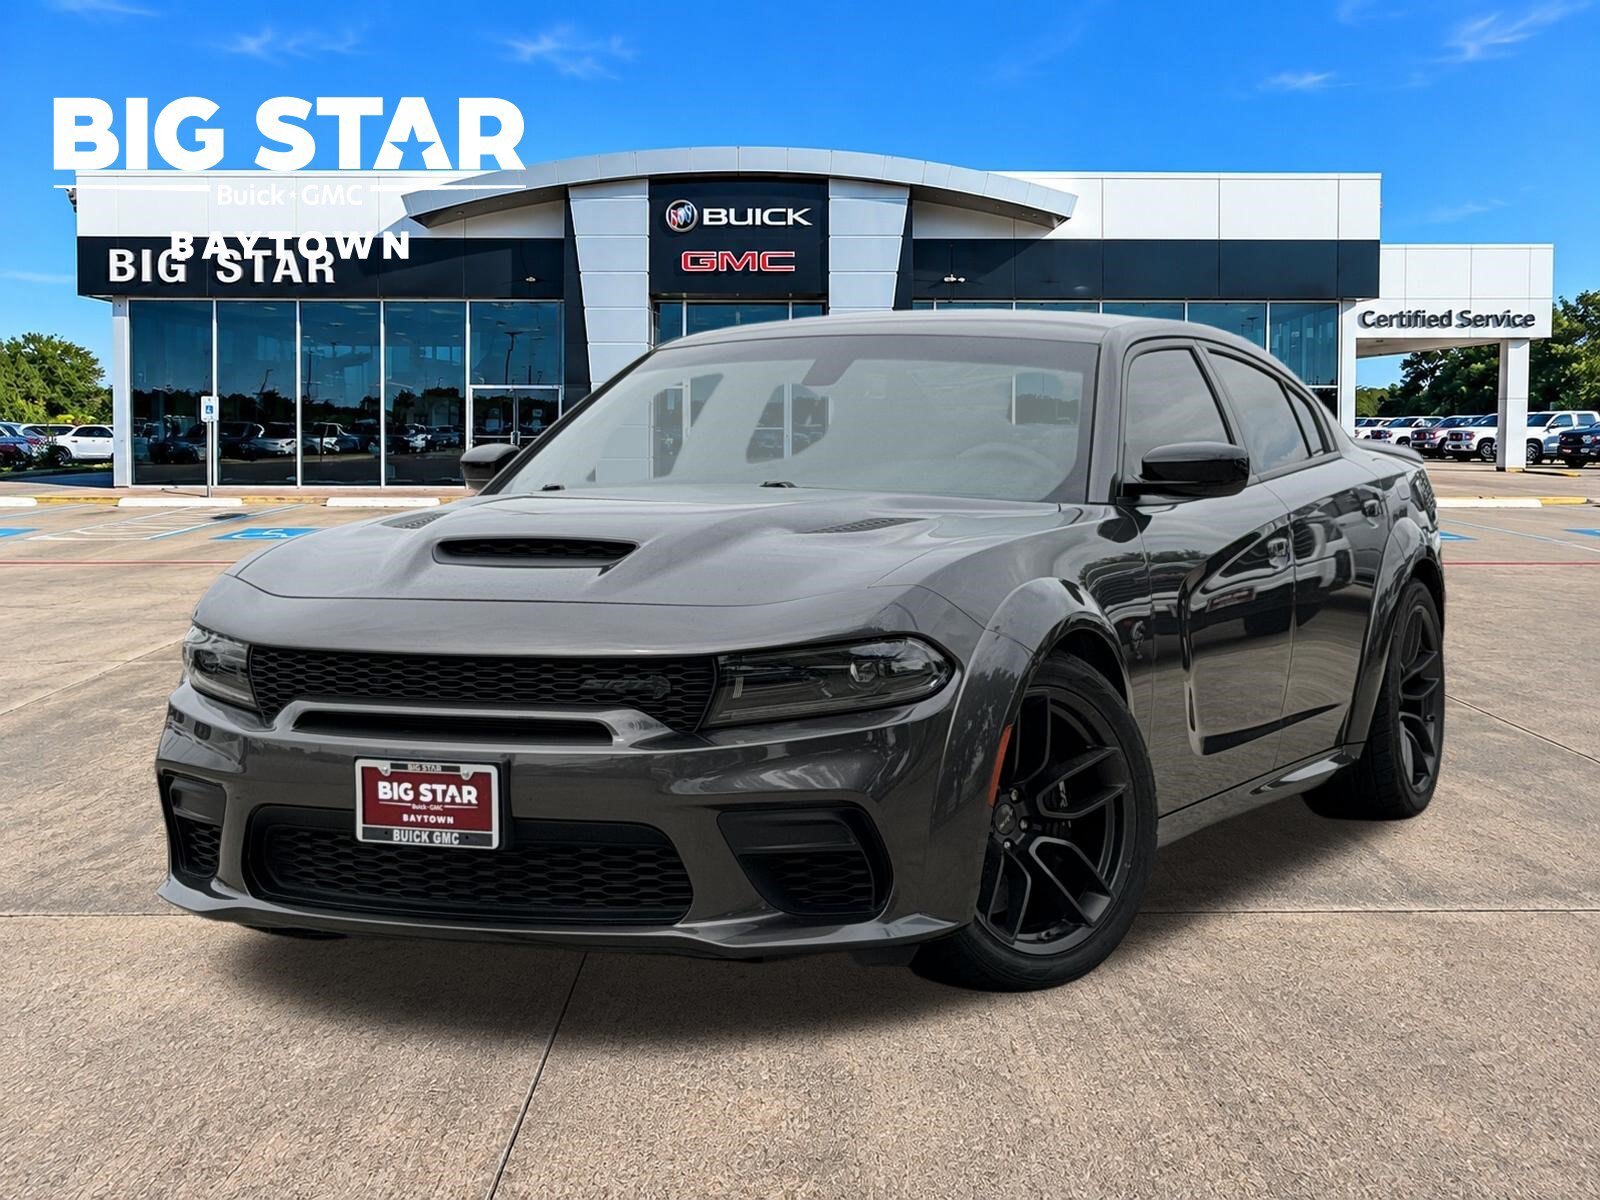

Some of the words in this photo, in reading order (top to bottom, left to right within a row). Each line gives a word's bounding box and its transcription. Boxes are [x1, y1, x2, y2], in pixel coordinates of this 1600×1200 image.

[703, 207, 813, 226] BUICK
[108, 248, 187, 284] BIG
[216, 248, 336, 284] STAR
[681, 251, 796, 272] GMC
[1359, 309, 1452, 328] Certified
[1456, 309, 1536, 328] Service
[407, 763, 421, 771] BIG
[422, 764, 442, 772] STAR
[377, 781, 414, 801] BIG
[419, 783, 478, 804] STAR
[402, 814, 454, 824] BAYTOWN
[393, 829, 429, 843] BUICK
[433, 831, 460, 844] GMC
